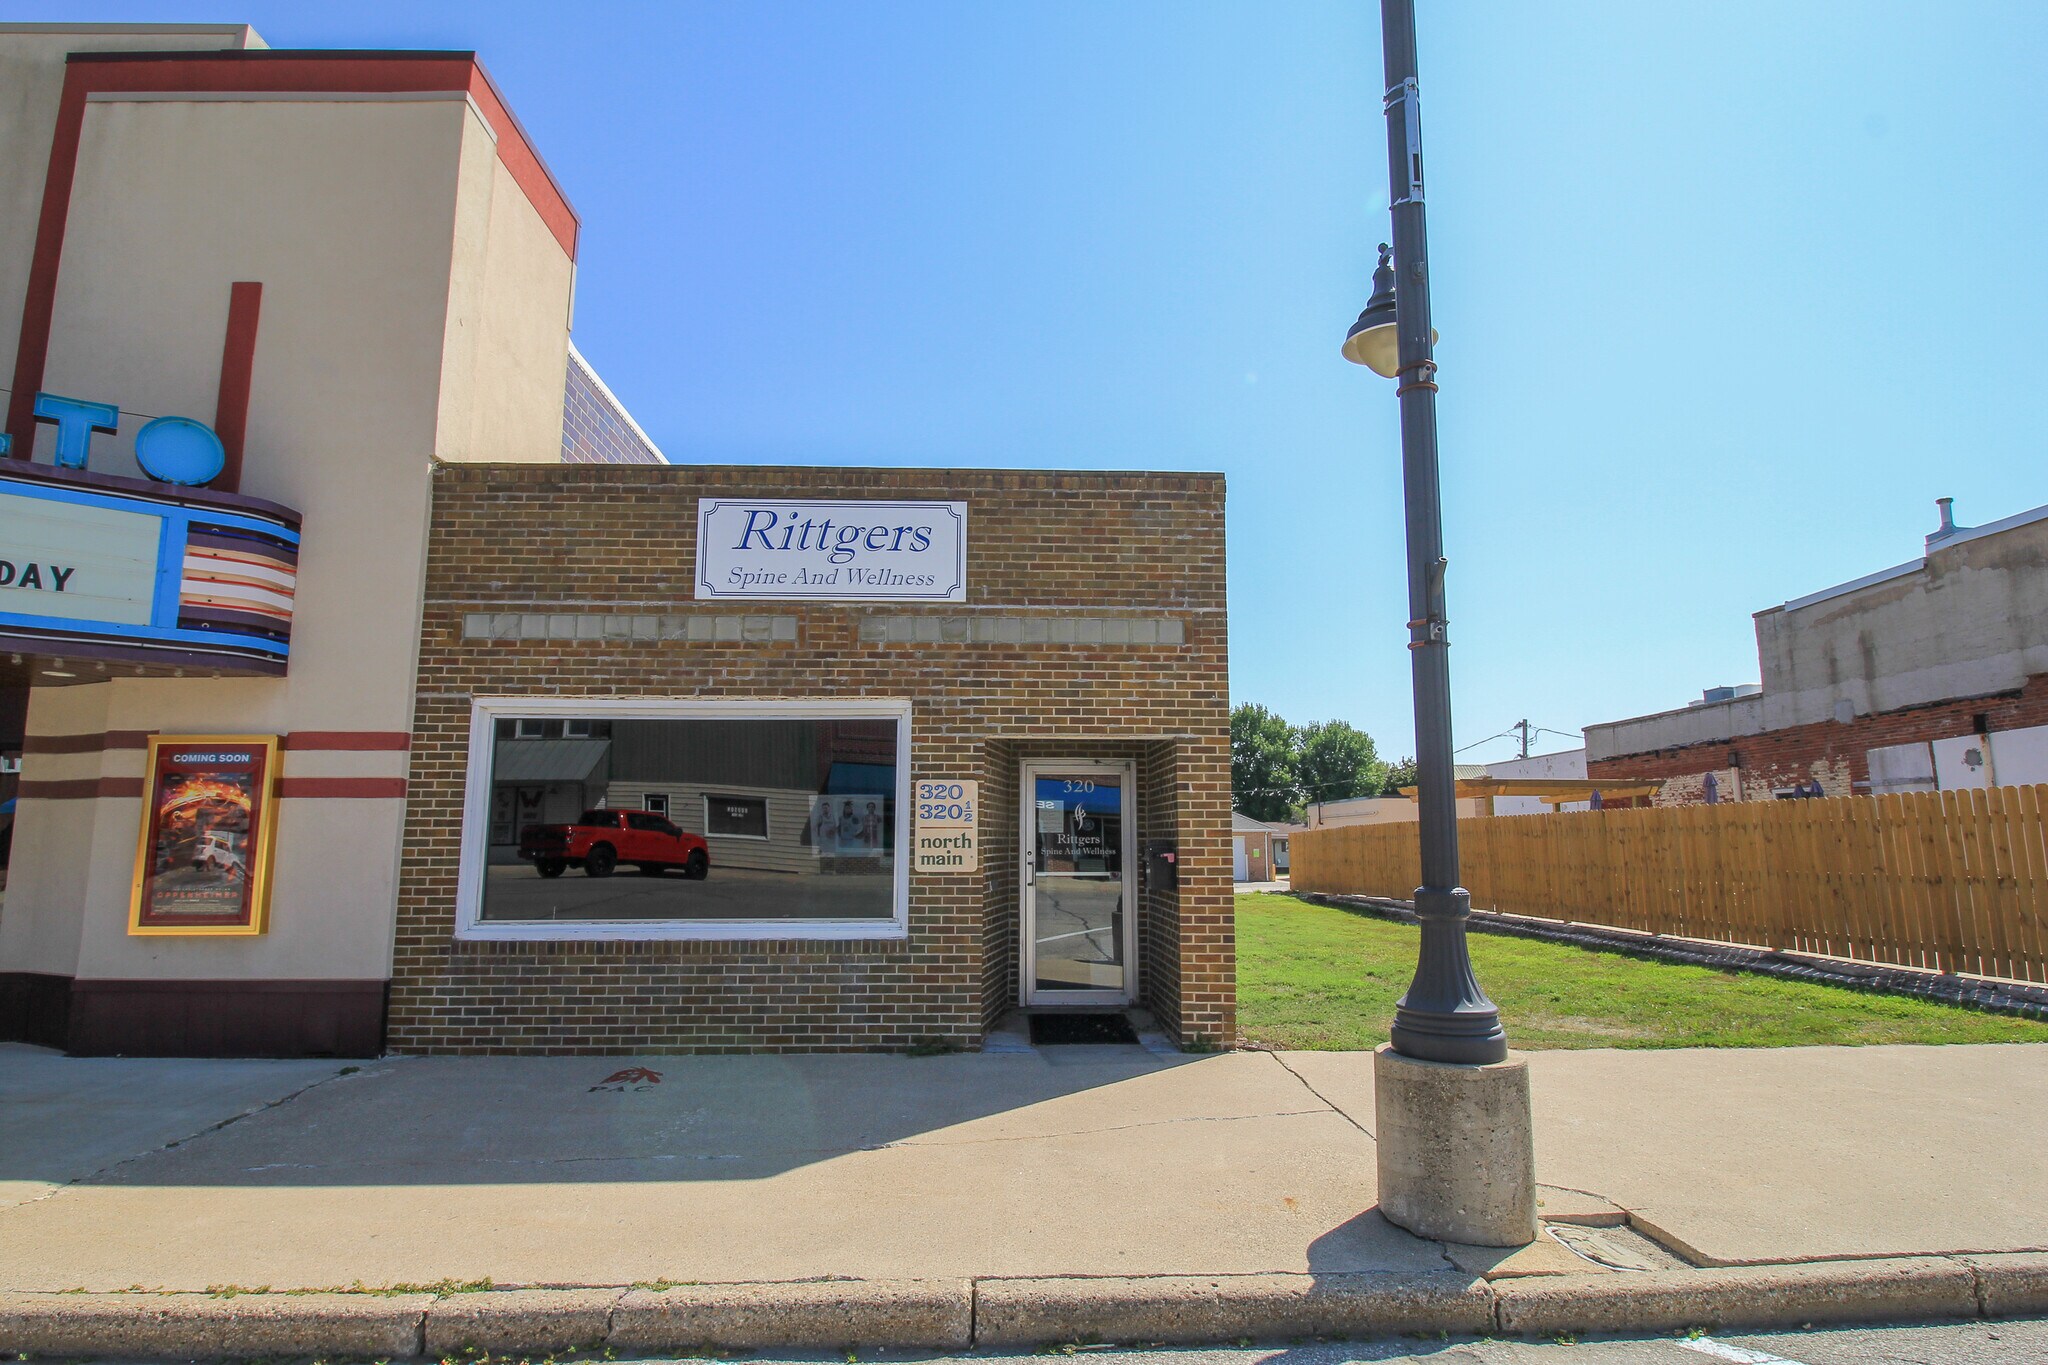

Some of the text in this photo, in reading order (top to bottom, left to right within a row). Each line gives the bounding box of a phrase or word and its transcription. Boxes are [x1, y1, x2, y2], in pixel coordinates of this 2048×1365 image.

[0, 391, 225, 486] TO
[731, 509, 932, 564] Rittgers
[727, 566, 935, 590] Spine And Wellness
[173, 754, 250, 762] COMING SOON
[919, 784, 963, 800] 320
[1063, 780, 1095, 793] 320
[920, 832, 972, 849] north
[1057, 833, 1101, 847] Rittgers
[920, 849, 963, 866] main
[1041, 847, 1116, 857] Spine And Wellness
